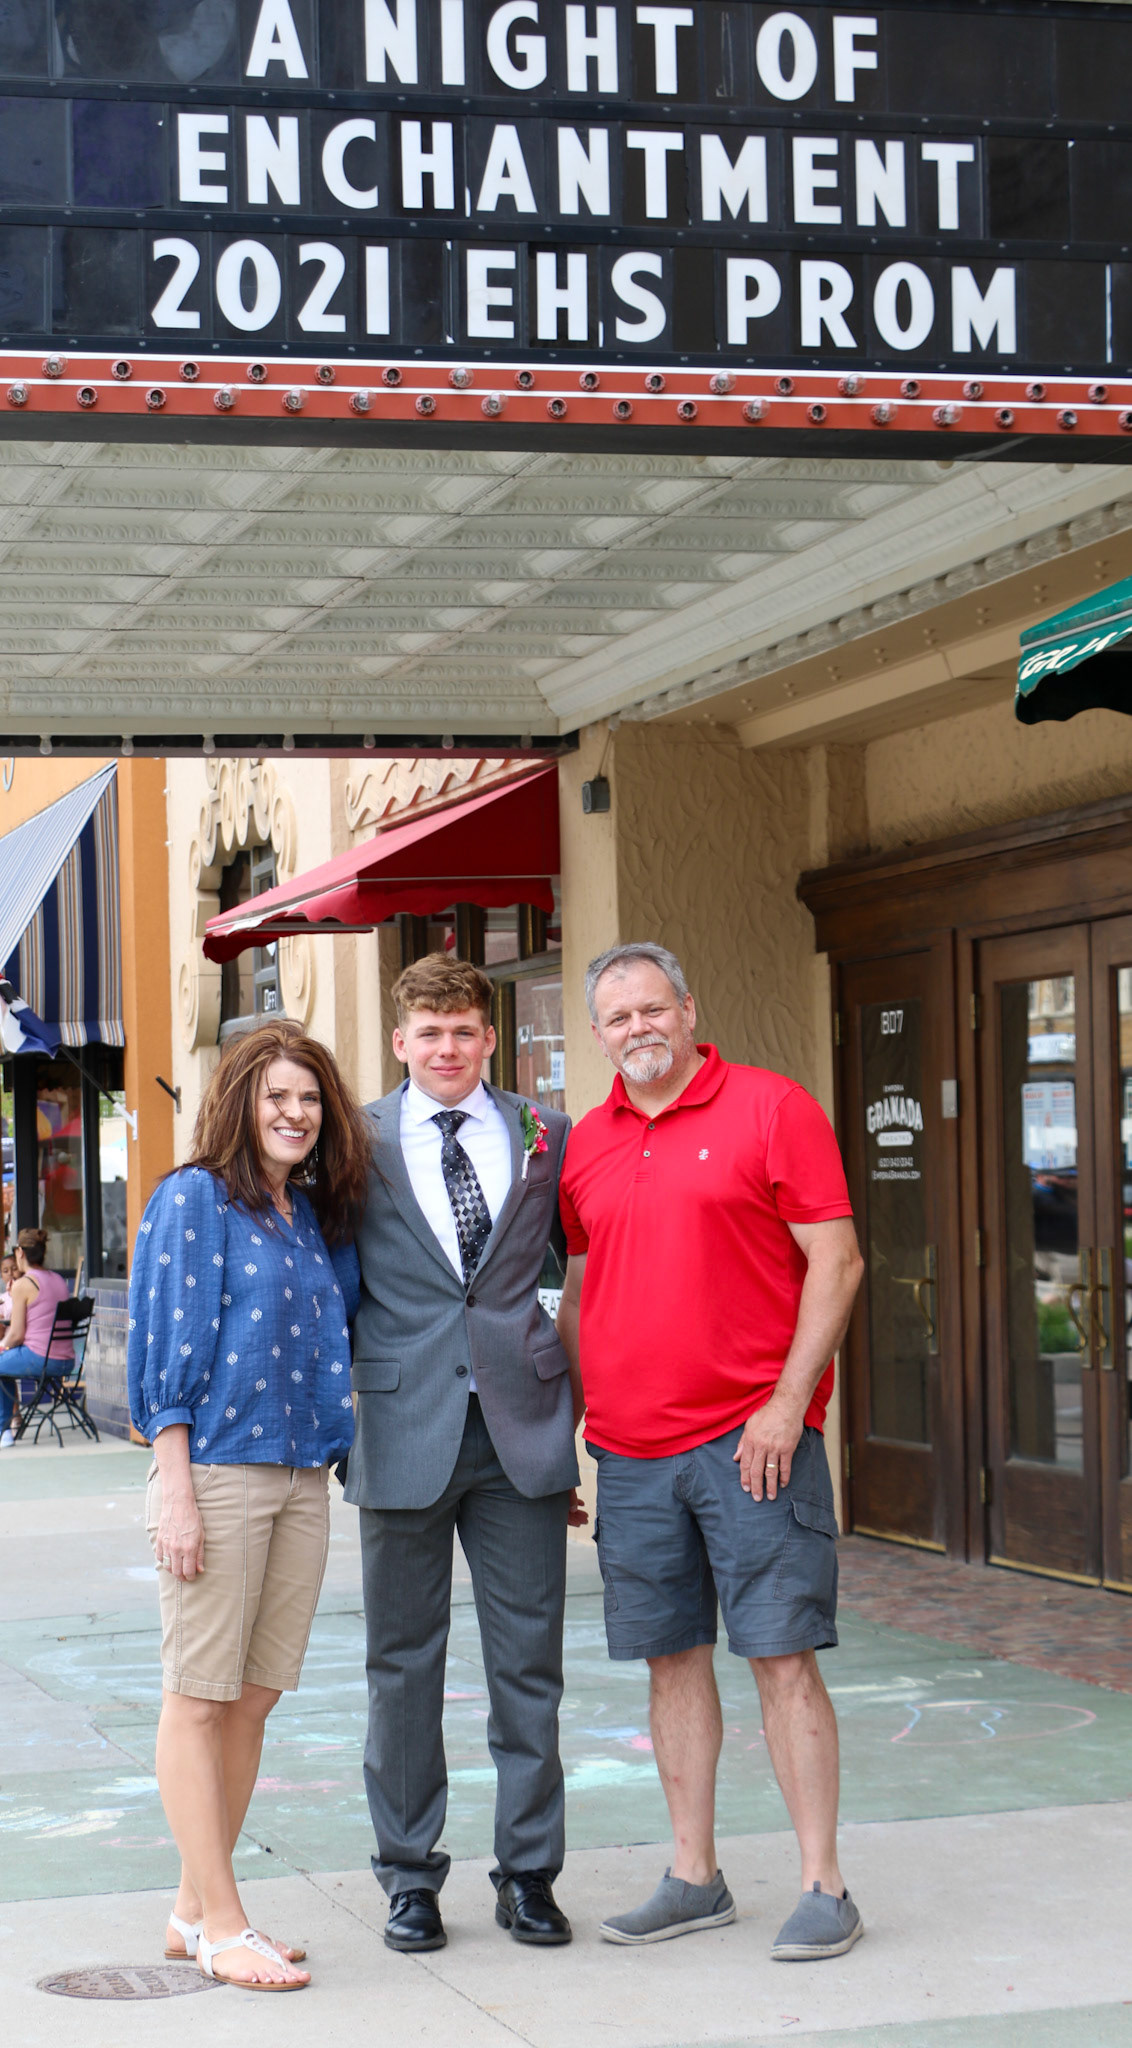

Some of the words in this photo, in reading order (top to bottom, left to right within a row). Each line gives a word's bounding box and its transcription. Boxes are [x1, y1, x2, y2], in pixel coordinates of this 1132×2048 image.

[245, 0, 309, 79] A
[364, 0, 694, 94] NIGHT
[756, 12, 878, 102] OF
[177, 112, 974, 230] ENCHANTMENT
[151, 237, 390, 335] 2021
[466, 249, 667, 343] EHS
[726, 257, 1016, 354] PROM
[880, 1009, 904, 1035] 807
[866, 1095, 924, 1134] GRANADA
